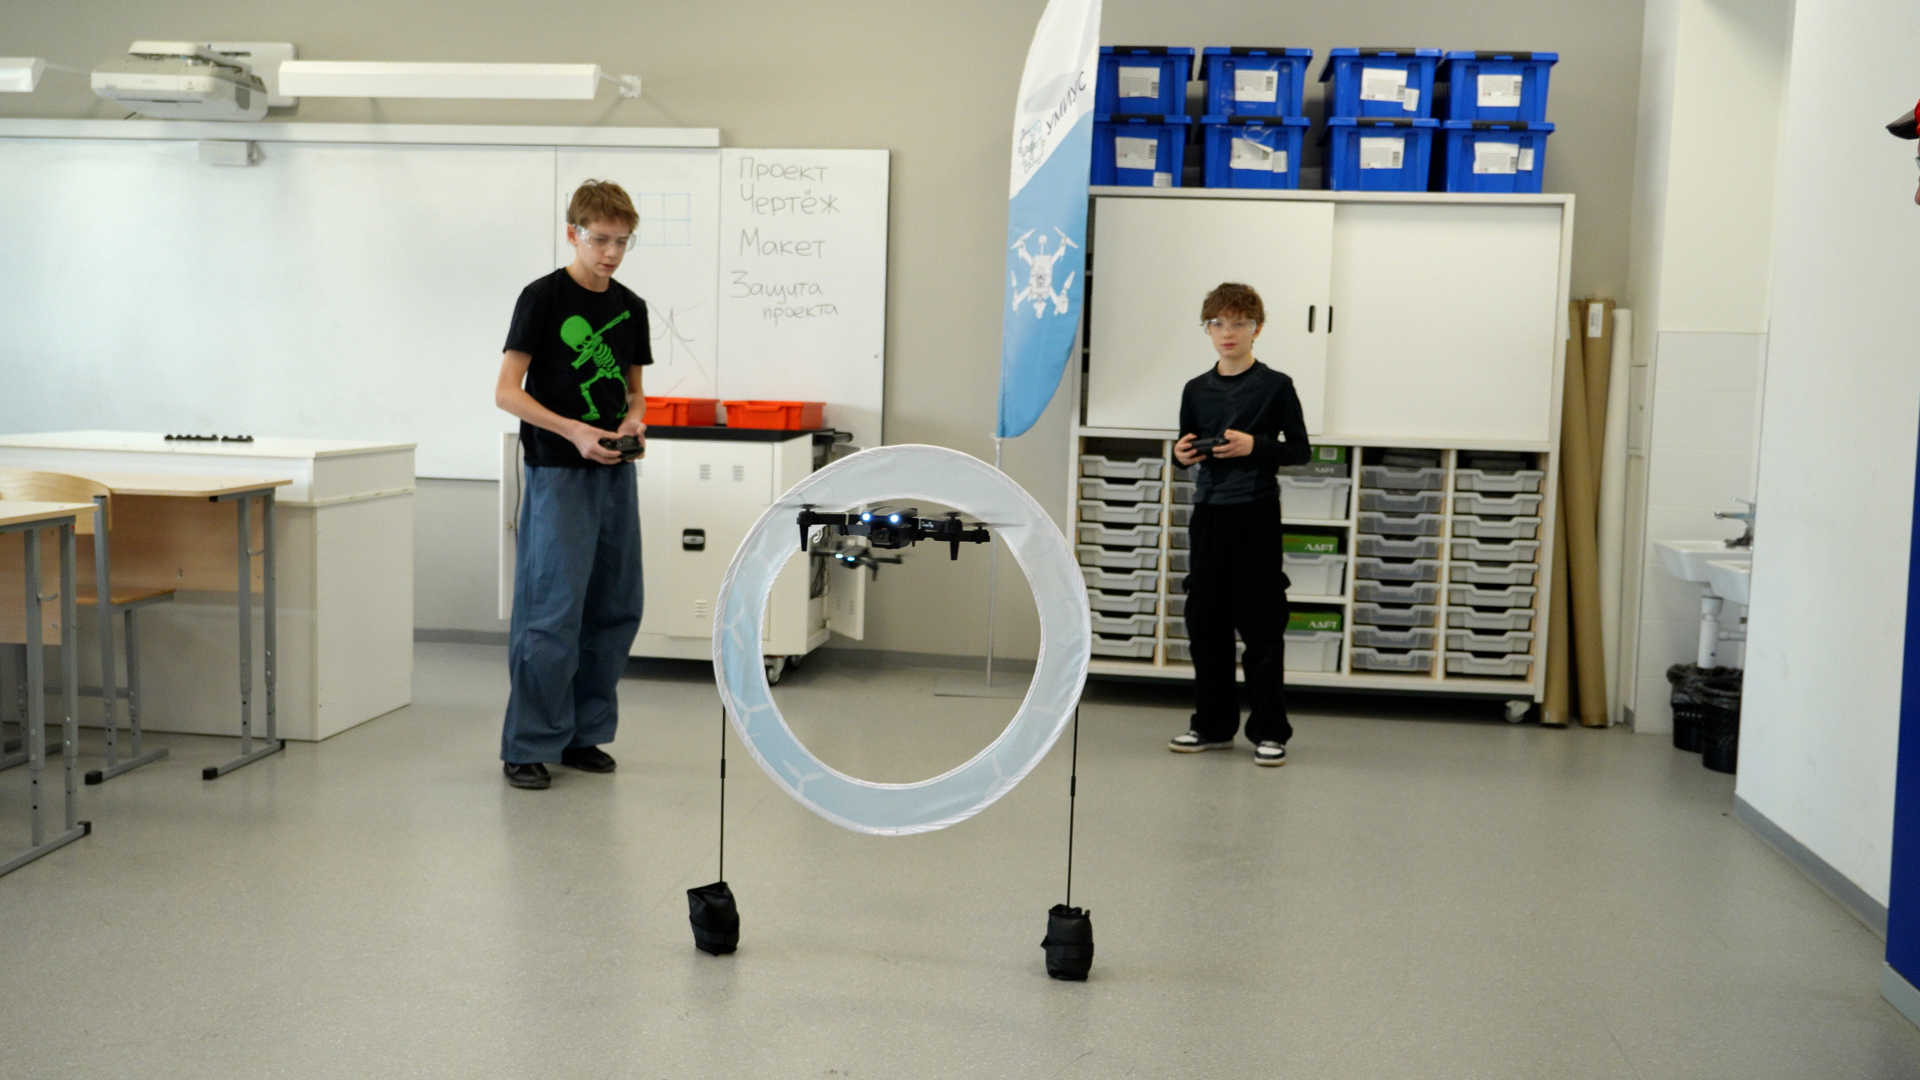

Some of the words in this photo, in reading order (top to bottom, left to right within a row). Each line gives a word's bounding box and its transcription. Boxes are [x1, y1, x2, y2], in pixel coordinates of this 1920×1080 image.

[1046, 71, 1086, 136] УМИУС
[740, 156, 829, 183] Проект
[740, 183, 841, 217] Чертёж
[739, 227, 827, 260] Макет
[730, 270, 824, 305] Защита
[762, 303, 839, 327] проекта
